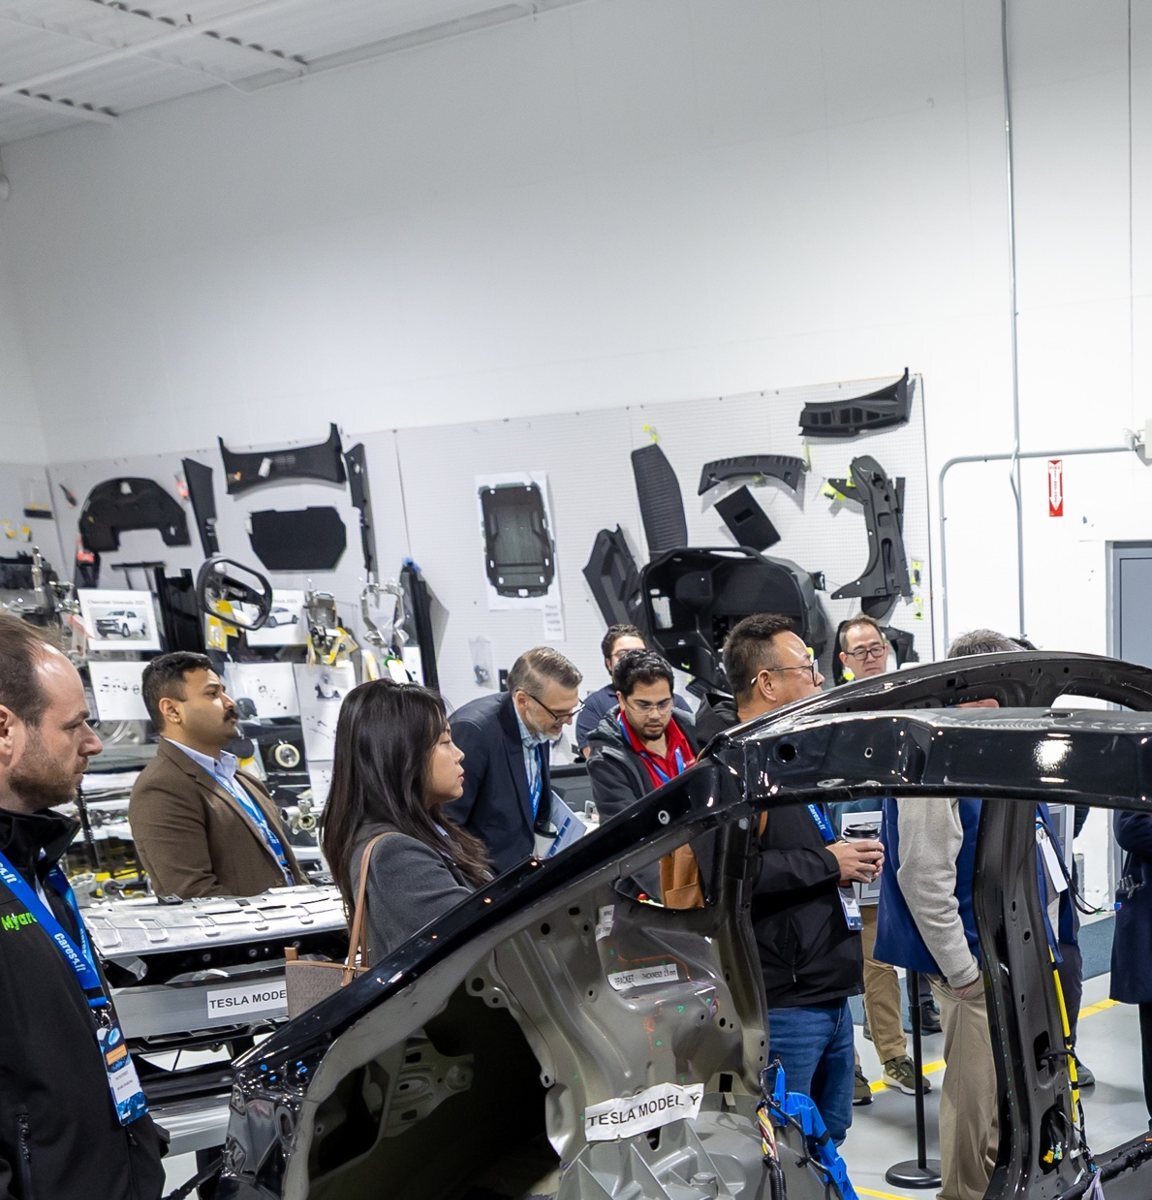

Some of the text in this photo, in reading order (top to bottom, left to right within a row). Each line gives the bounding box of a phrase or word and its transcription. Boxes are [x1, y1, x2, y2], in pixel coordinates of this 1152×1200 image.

[209, 989, 287, 1009] TESLA MODE
[587, 1094, 700, 1126] TESLA MODEL Y
